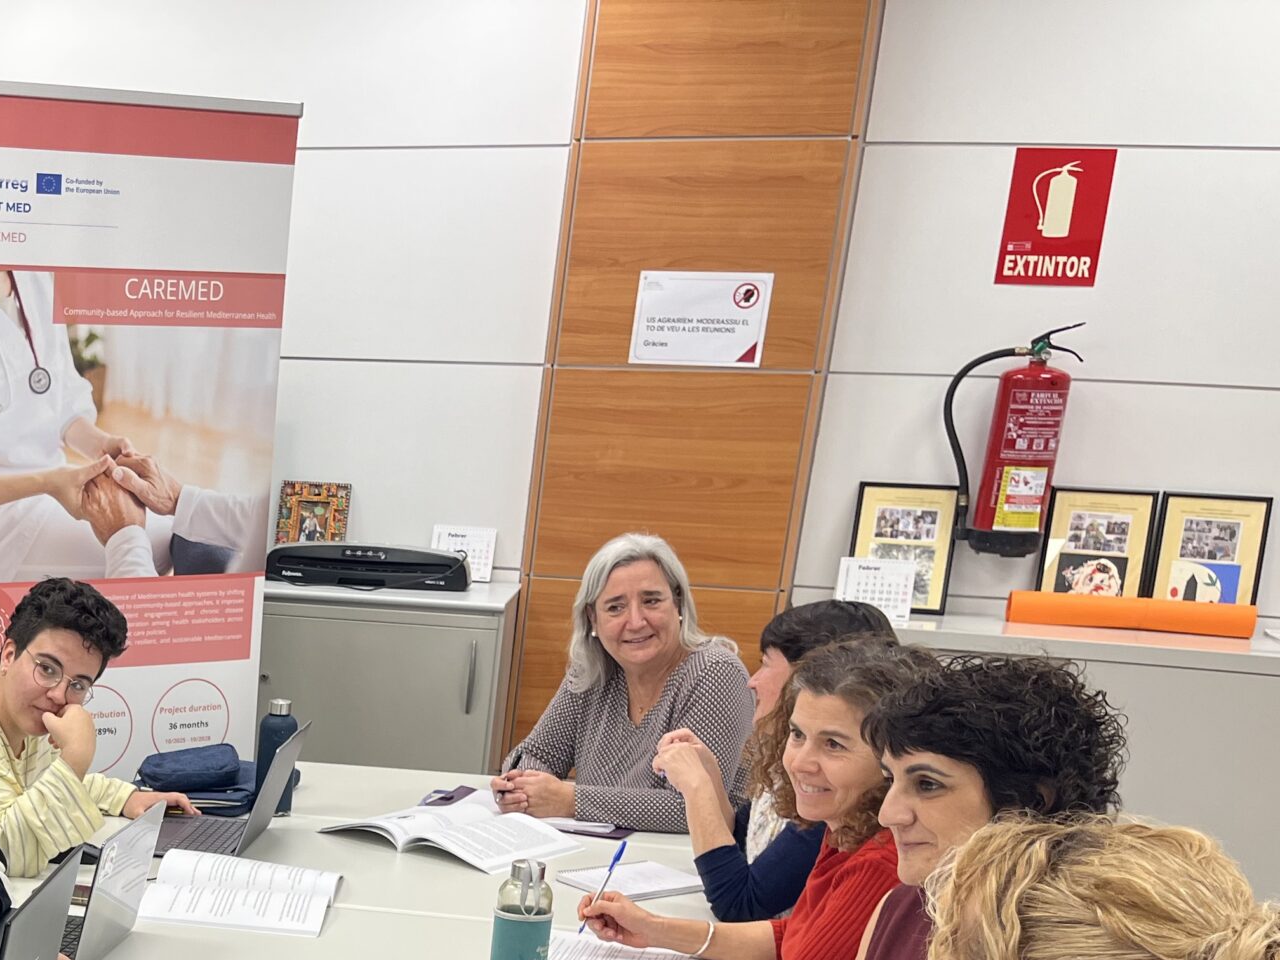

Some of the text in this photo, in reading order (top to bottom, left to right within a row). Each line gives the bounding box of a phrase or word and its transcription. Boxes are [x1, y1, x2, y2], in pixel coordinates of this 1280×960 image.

[65, 177, 103, 188] Co-funded by
[65, 186, 120, 196] the European Union
[5, 201, 32, 213] MED
[1002, 255, 1091, 278] EXTINTOR
[124, 277, 224, 301] CAREMED
[63, 307, 277, 321] Community-based Approach for Resilient Mediterranean Health
[701, 326, 736, 334] REUNIONS
[90, 710, 126, 720] tribution
[158, 703, 222, 716] Project duration
[168, 720, 209, 731] 36 months
